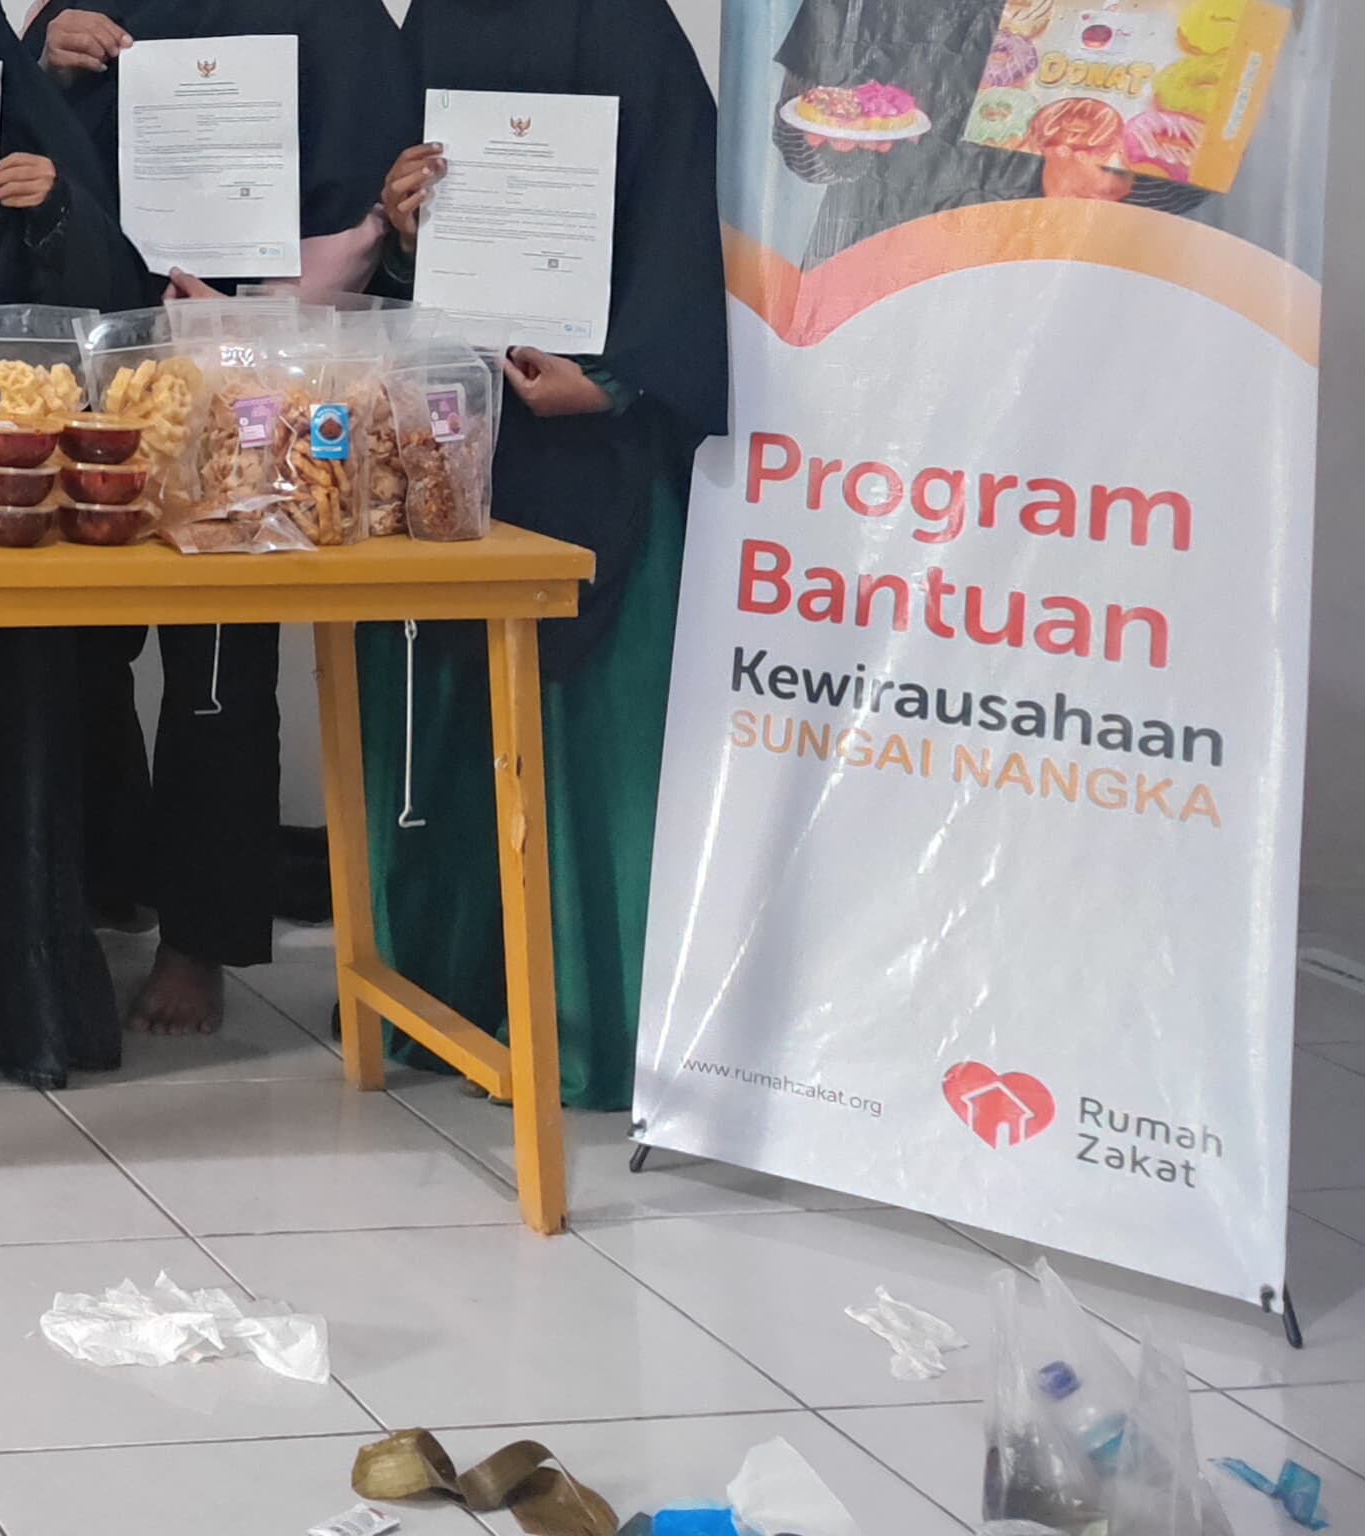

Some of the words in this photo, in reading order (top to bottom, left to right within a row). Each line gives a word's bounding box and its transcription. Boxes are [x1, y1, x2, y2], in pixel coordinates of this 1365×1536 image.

[1038, 50, 1155, 97] DONAT
[745, 431, 1192, 552] Program
[736, 539, 1169, 668] Bantuan
[731, 646, 1224, 767] Kewirausahaan
[730, 710, 933, 777] SUNGAI
[953, 743, 1222, 829] NANGKA
[681, 1057, 883, 1117] www.rumahzakat.org
[1079, 1096, 1223, 1158] Rumah
[1076, 1132, 1196, 1189] Zakat
